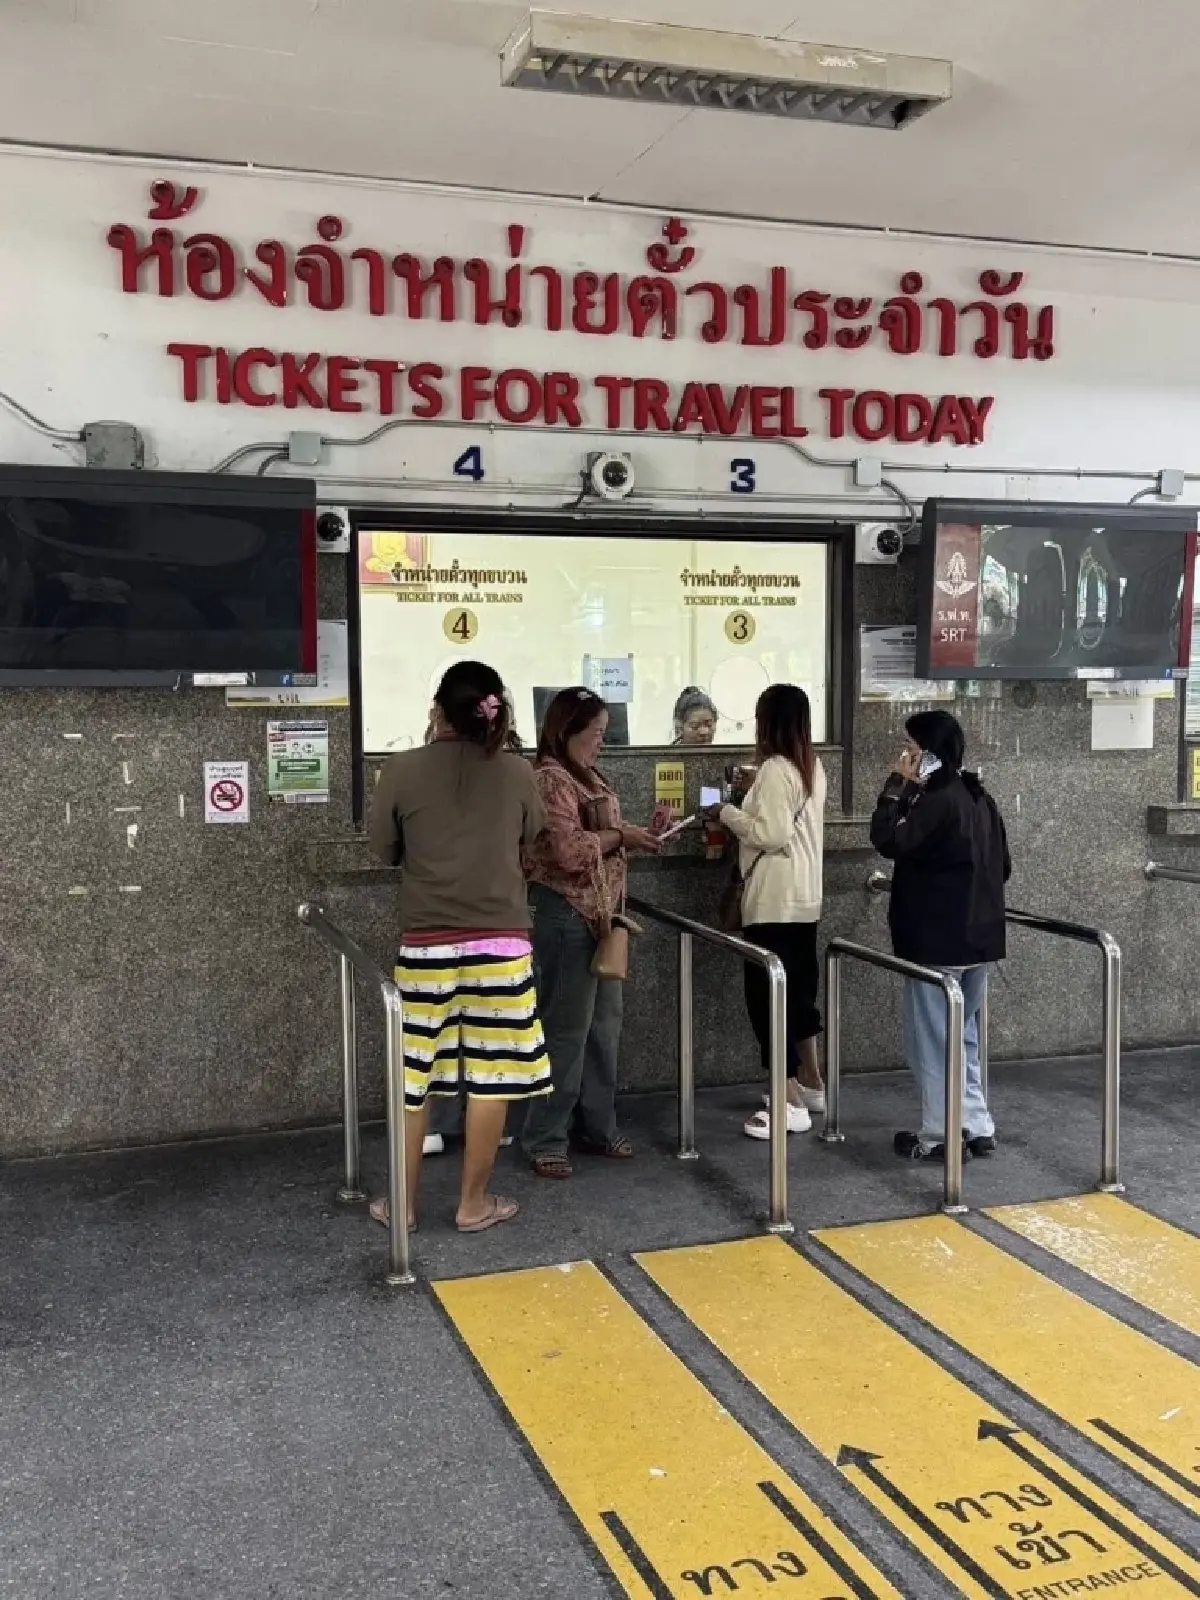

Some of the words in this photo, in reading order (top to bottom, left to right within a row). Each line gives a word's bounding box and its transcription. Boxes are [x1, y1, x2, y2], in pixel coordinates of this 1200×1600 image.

[108, 181, 1054, 360] ห้องจำหน่ายตั๋วประจำวัน
[168, 343, 443, 418] TICKETS
[461, 367, 582, 427] FOR
[594, 377, 809, 438] TRAVEL
[819, 388, 994, 445] TODAY
[453, 446, 485, 484] 4
[730, 458, 756, 495] 3
[396, 592, 436, 603] TICKET
[437, 592, 459, 603] FOR
[461, 592, 484, 603] ALL
[485, 592, 523, 603] TRAINS
[683, 596, 719, 606] TICKET
[720, 596, 739, 606] FOR
[741, 596, 761, 606] ALL
[762, 596, 797, 606] TRAINS
[452, 611, 470, 640] 4
[733, 613, 748, 640] 3
[940, 627, 968, 643] SRT
[935, 1483, 1053, 1524] ทาง
[994, 1521, 1109, 1571] เข้า
[680, 1551, 809, 1596] ทาง
[1015, 1561, 1162, 1600] ENTRANCE
